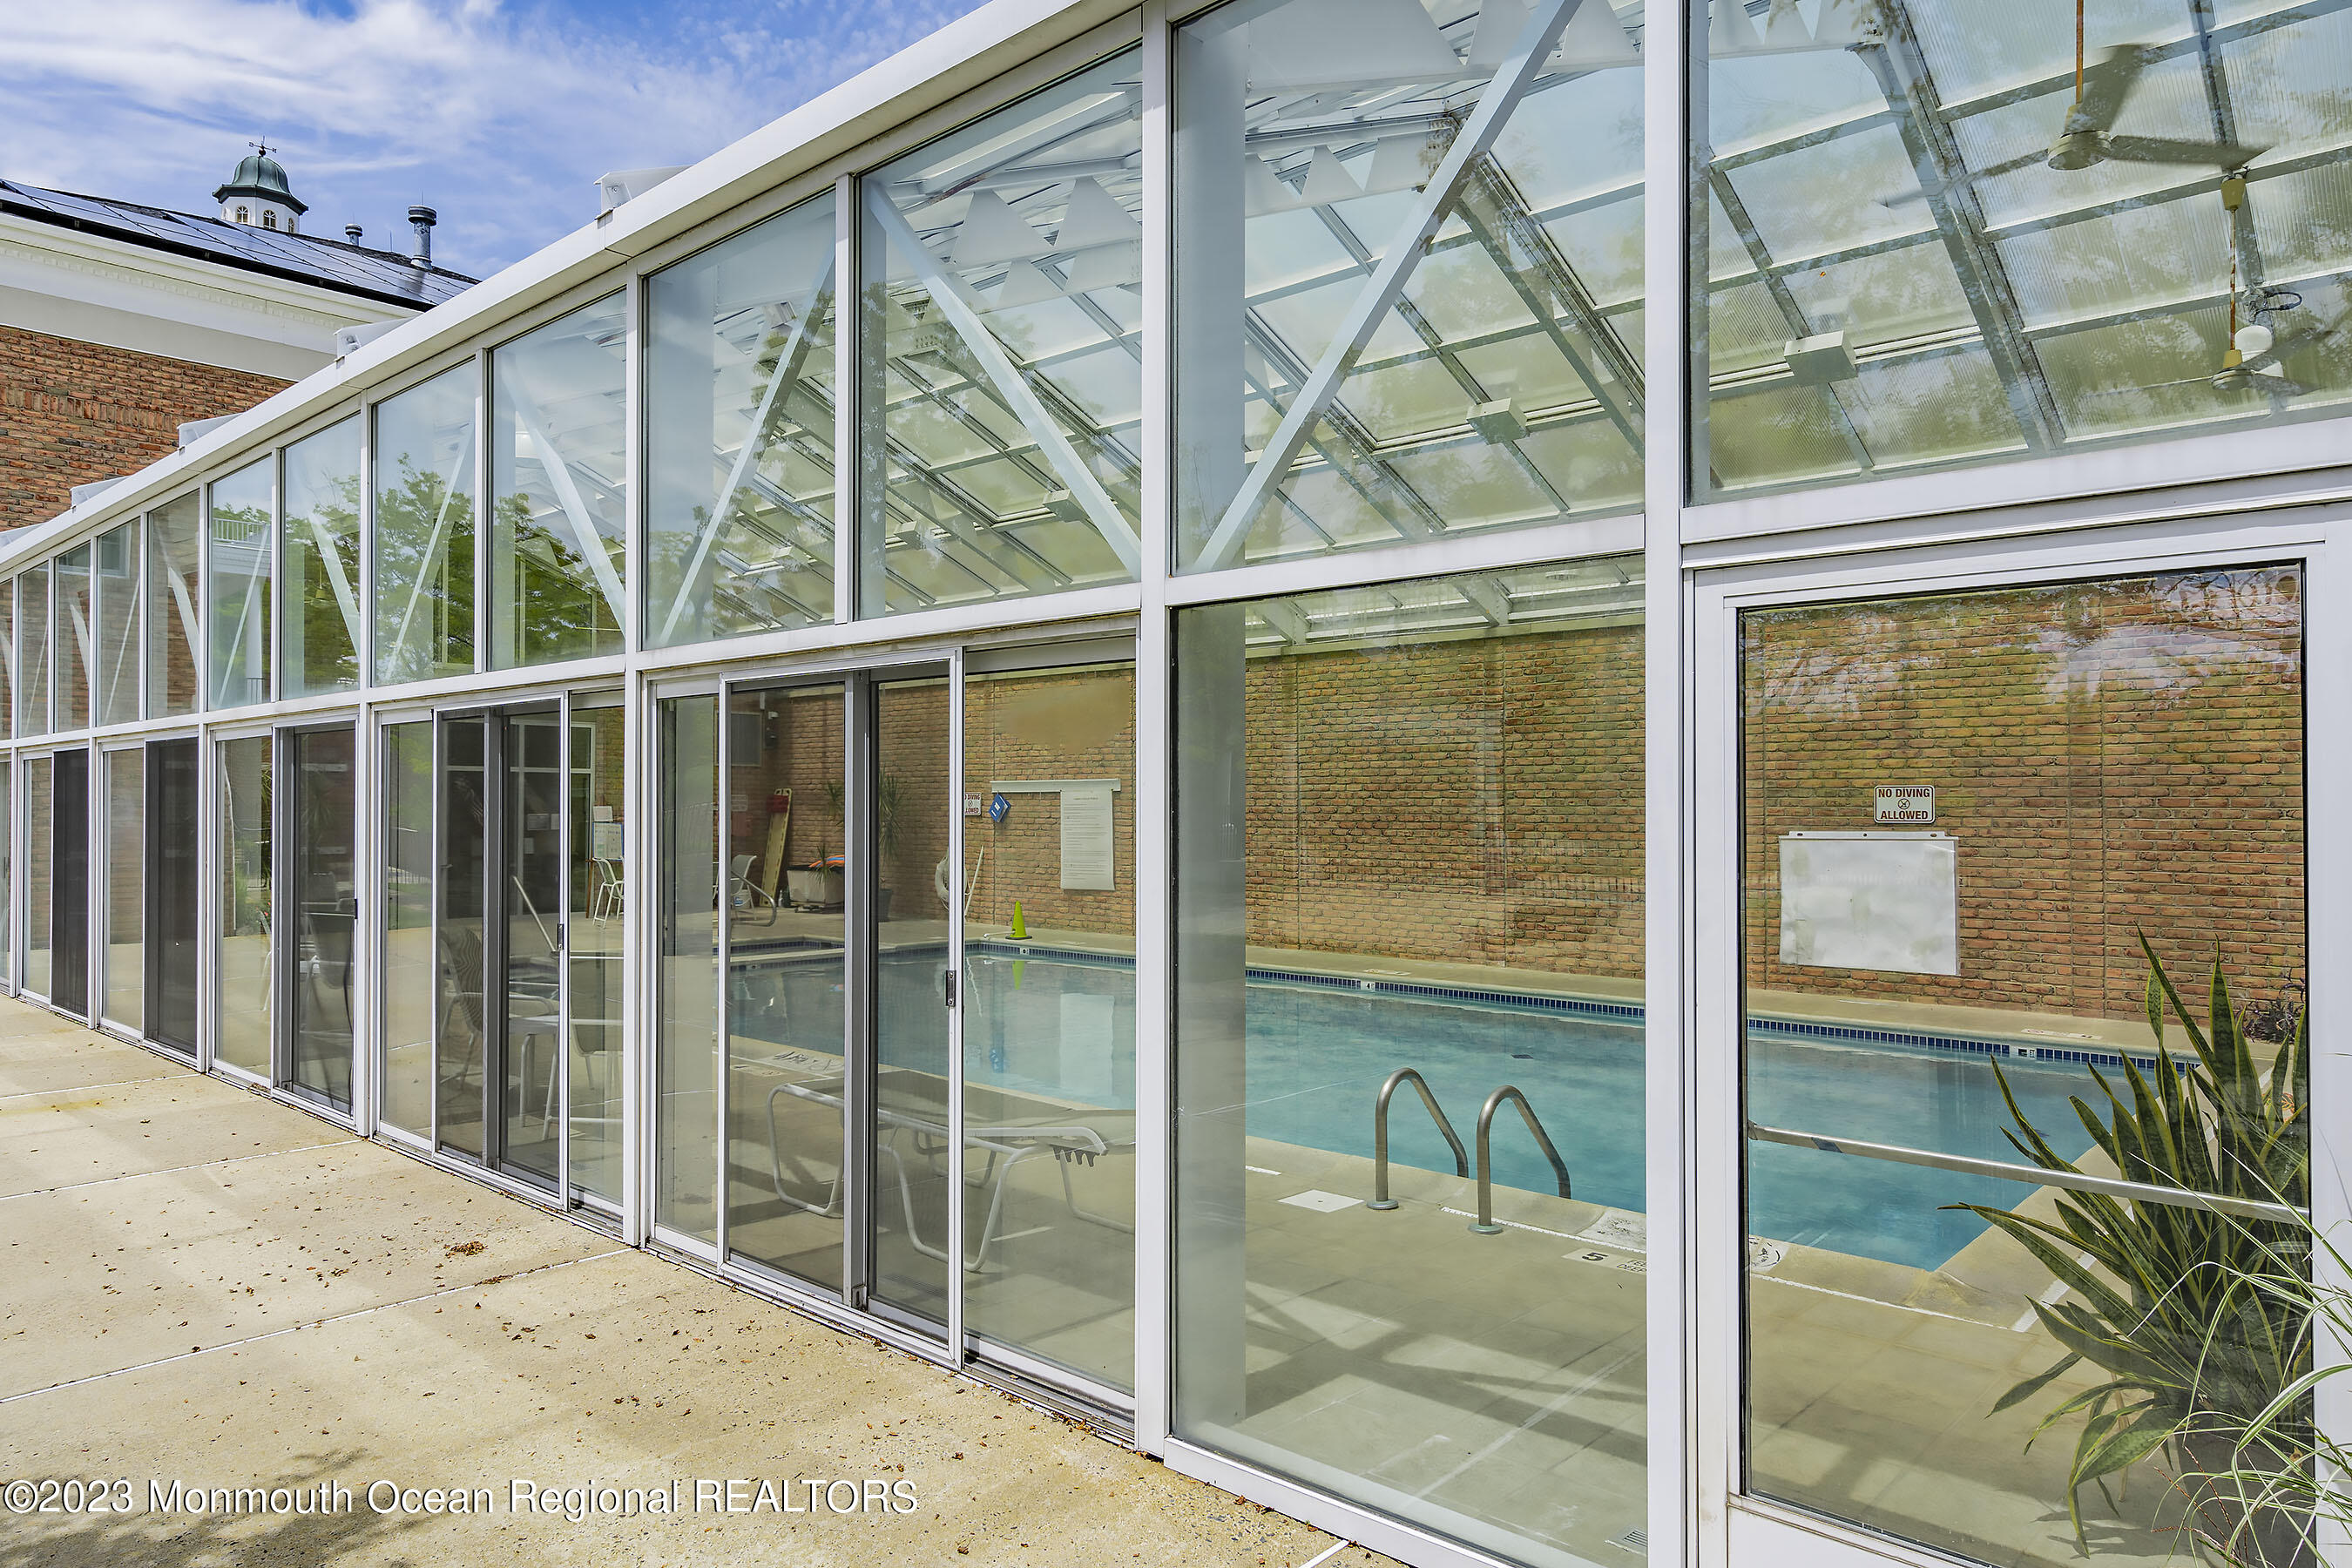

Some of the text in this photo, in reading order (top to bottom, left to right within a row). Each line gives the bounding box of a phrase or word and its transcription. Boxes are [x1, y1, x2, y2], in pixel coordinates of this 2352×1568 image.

[1878, 788, 1930, 798] NO DIVING
[1880, 810, 1929, 820] ALLOWED
[1581, 1252, 1609, 1261] 5
